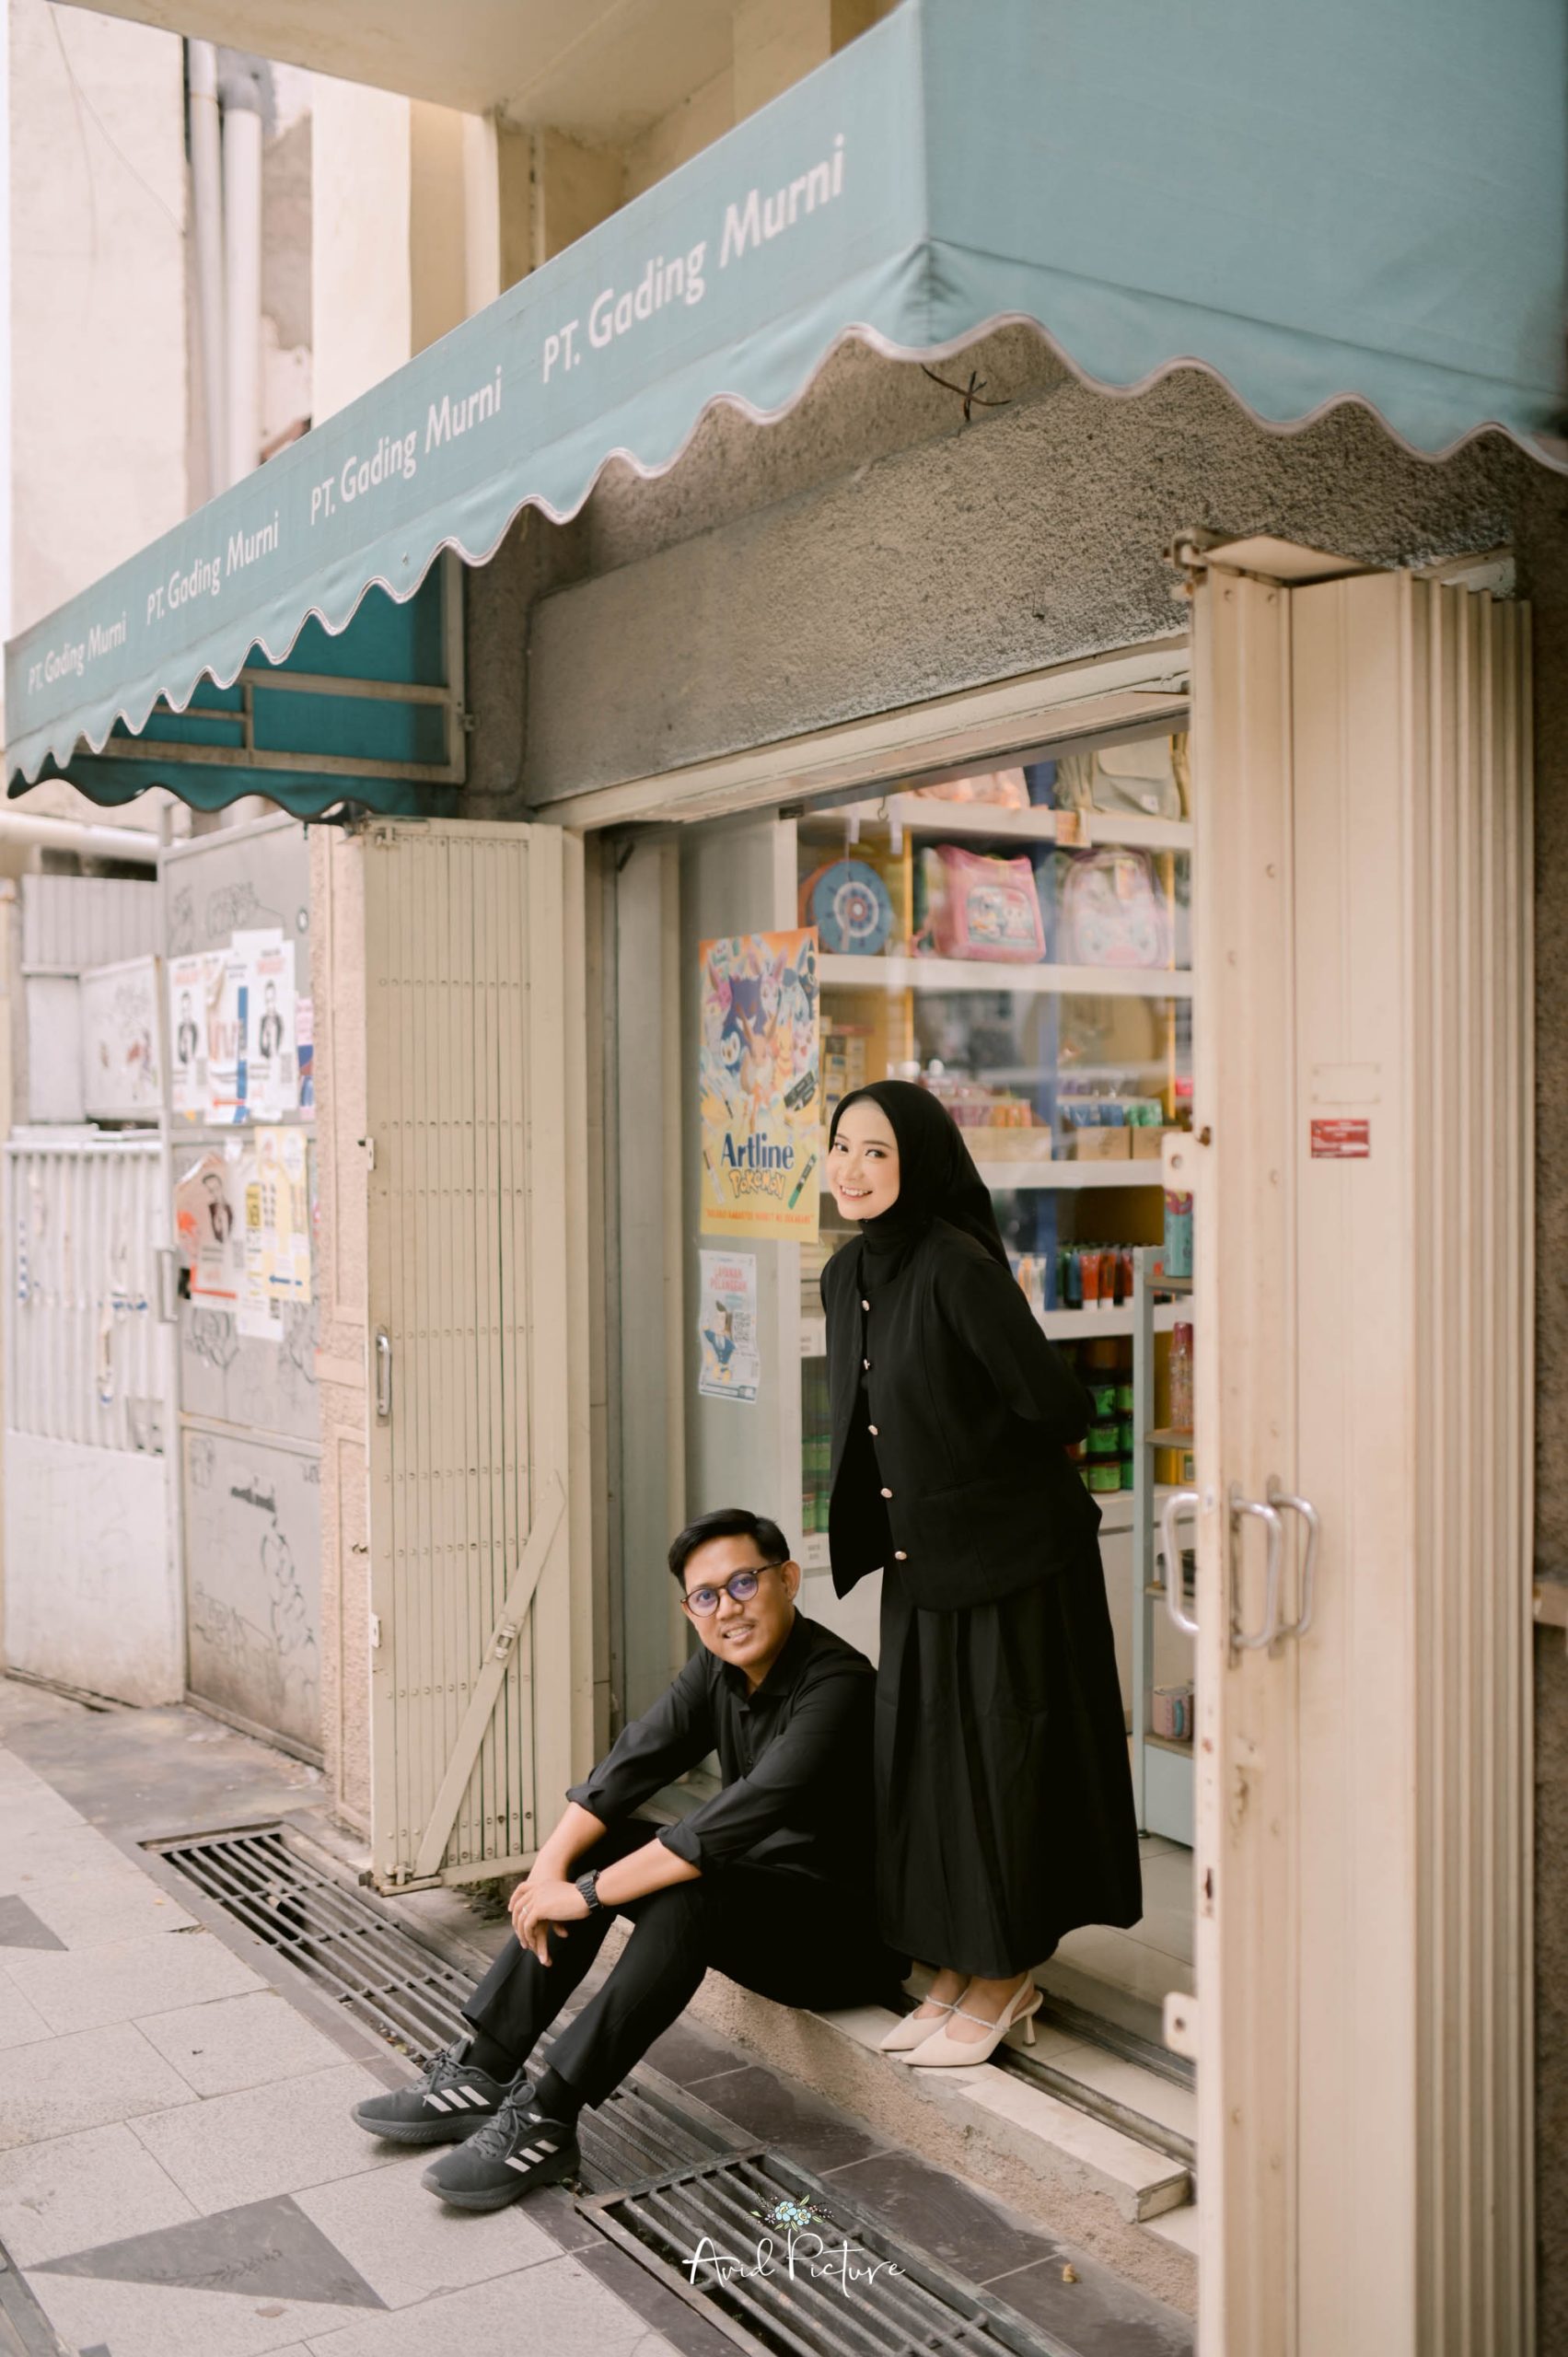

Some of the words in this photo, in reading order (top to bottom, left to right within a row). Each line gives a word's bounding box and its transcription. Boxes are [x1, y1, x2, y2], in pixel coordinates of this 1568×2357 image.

[542, 319, 581, 384] PT.
[587, 241, 707, 349] Gading
[719, 132, 845, 269] Murni
[310, 477, 336, 526] PT.
[341, 430, 417, 503] Gading
[424, 365, 502, 454] Murni
[145, 586, 166, 626] PT.
[168, 556, 222, 610] Gading
[226, 509, 279, 576] Murni
[28, 662, 43, 695] PT.
[45, 642, 86, 684] Gading
[87, 610, 127, 662] Murni
[720, 1132, 795, 1170] Artline
